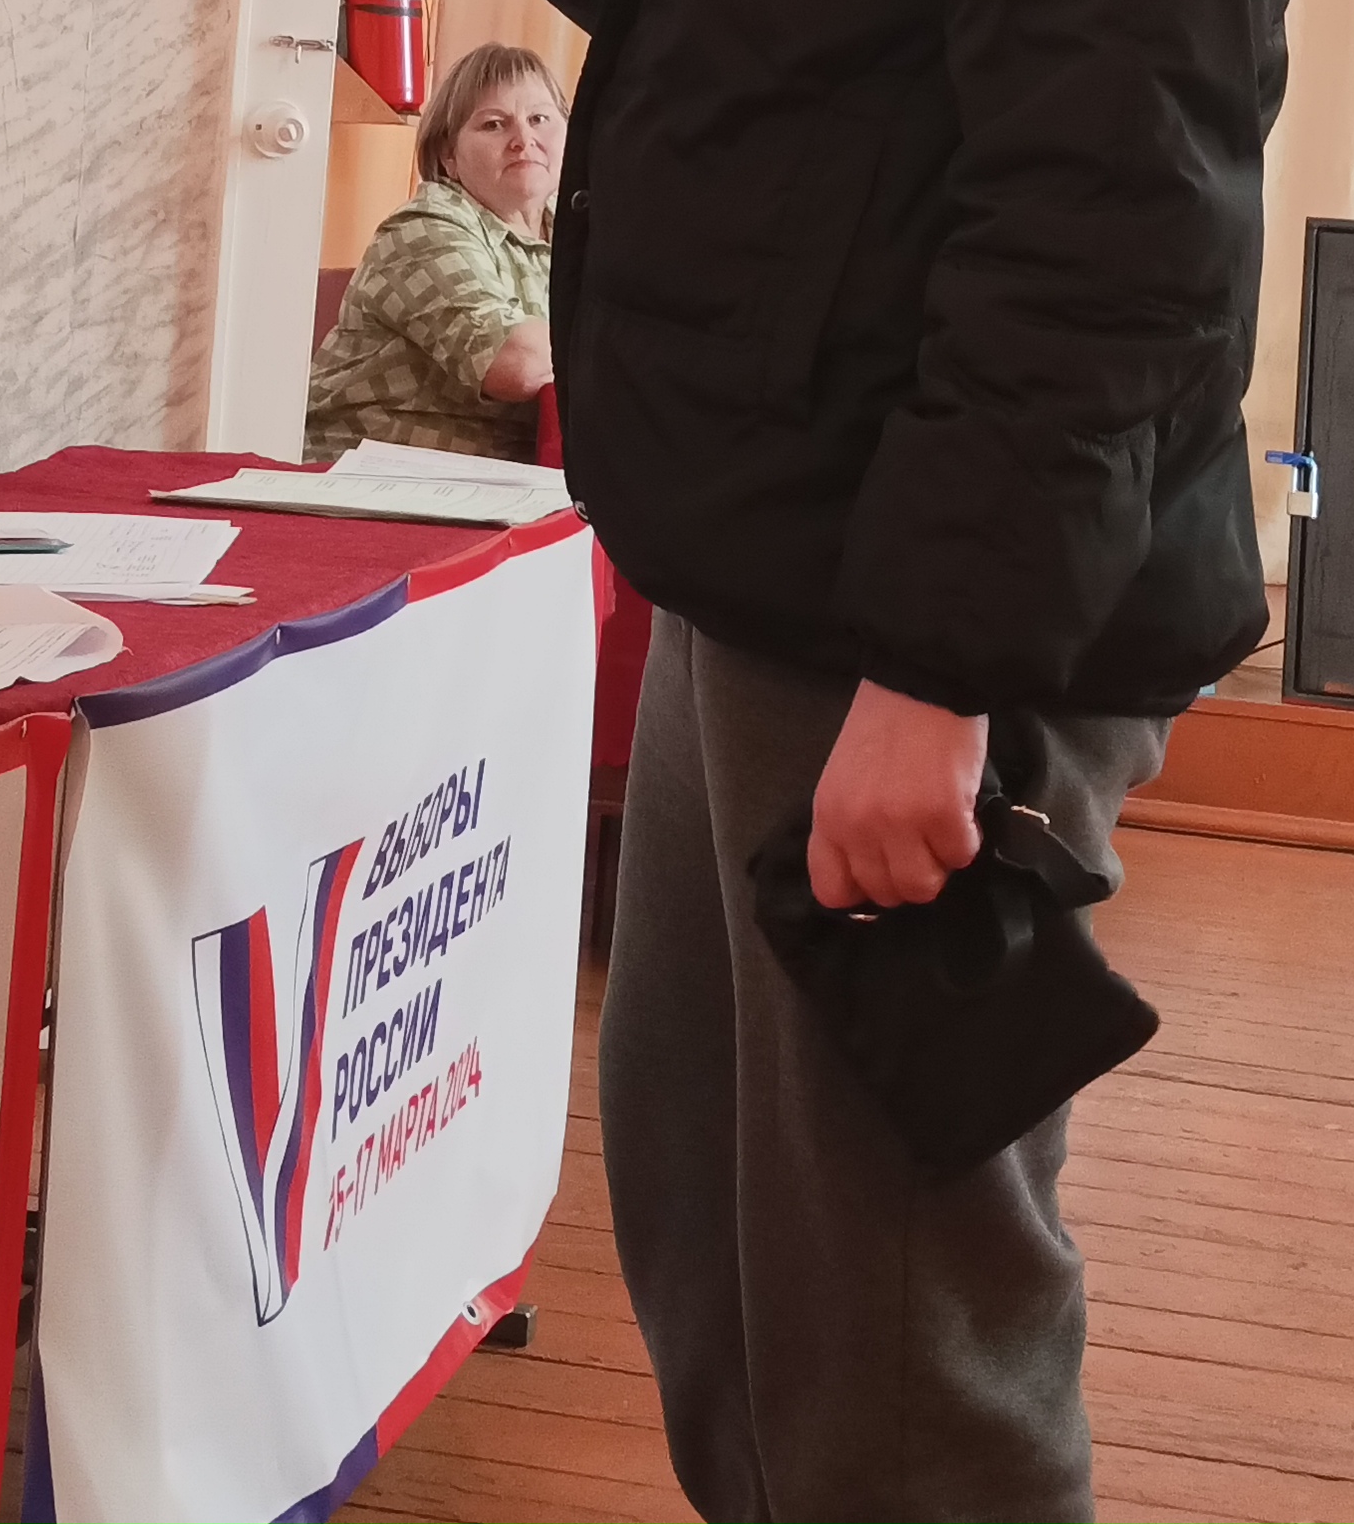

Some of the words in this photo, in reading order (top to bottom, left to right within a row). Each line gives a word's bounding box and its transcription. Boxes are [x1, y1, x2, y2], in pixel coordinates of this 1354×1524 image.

[362, 757, 486, 900] ВЫБОРЫ
[342, 835, 512, 1019] ПРЕЗИДЕНТА
[331, 978, 442, 1144] РОССИИ
[374, 1075, 440, 1196] МАРТА
[440, 1035, 482, 1131] 2024
